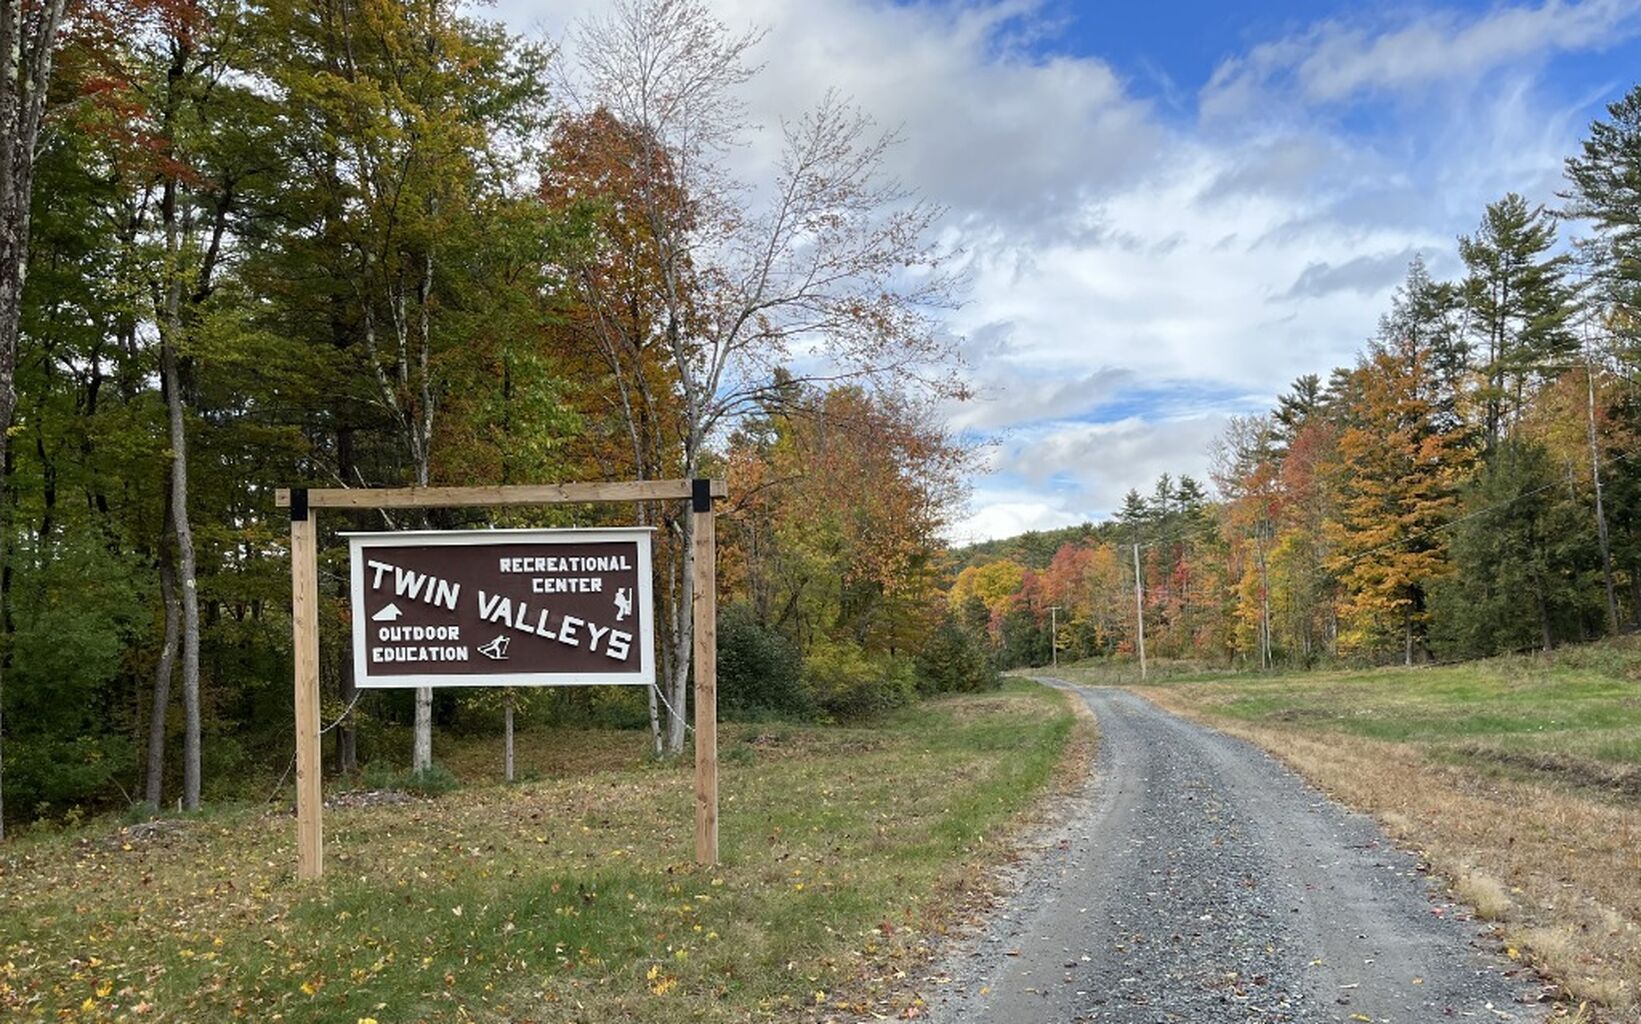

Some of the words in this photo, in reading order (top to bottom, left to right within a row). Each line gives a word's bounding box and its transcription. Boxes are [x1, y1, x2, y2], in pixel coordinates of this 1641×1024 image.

[500, 555, 632, 573] RECREATIONAL
[532, 578, 602, 593] CENTER
[368, 559, 461, 611] TWIN
[478, 590, 633, 662] VALLEYS
[378, 626, 459, 642] OUTDOOR
[372, 646, 468, 663] EDUCATION
